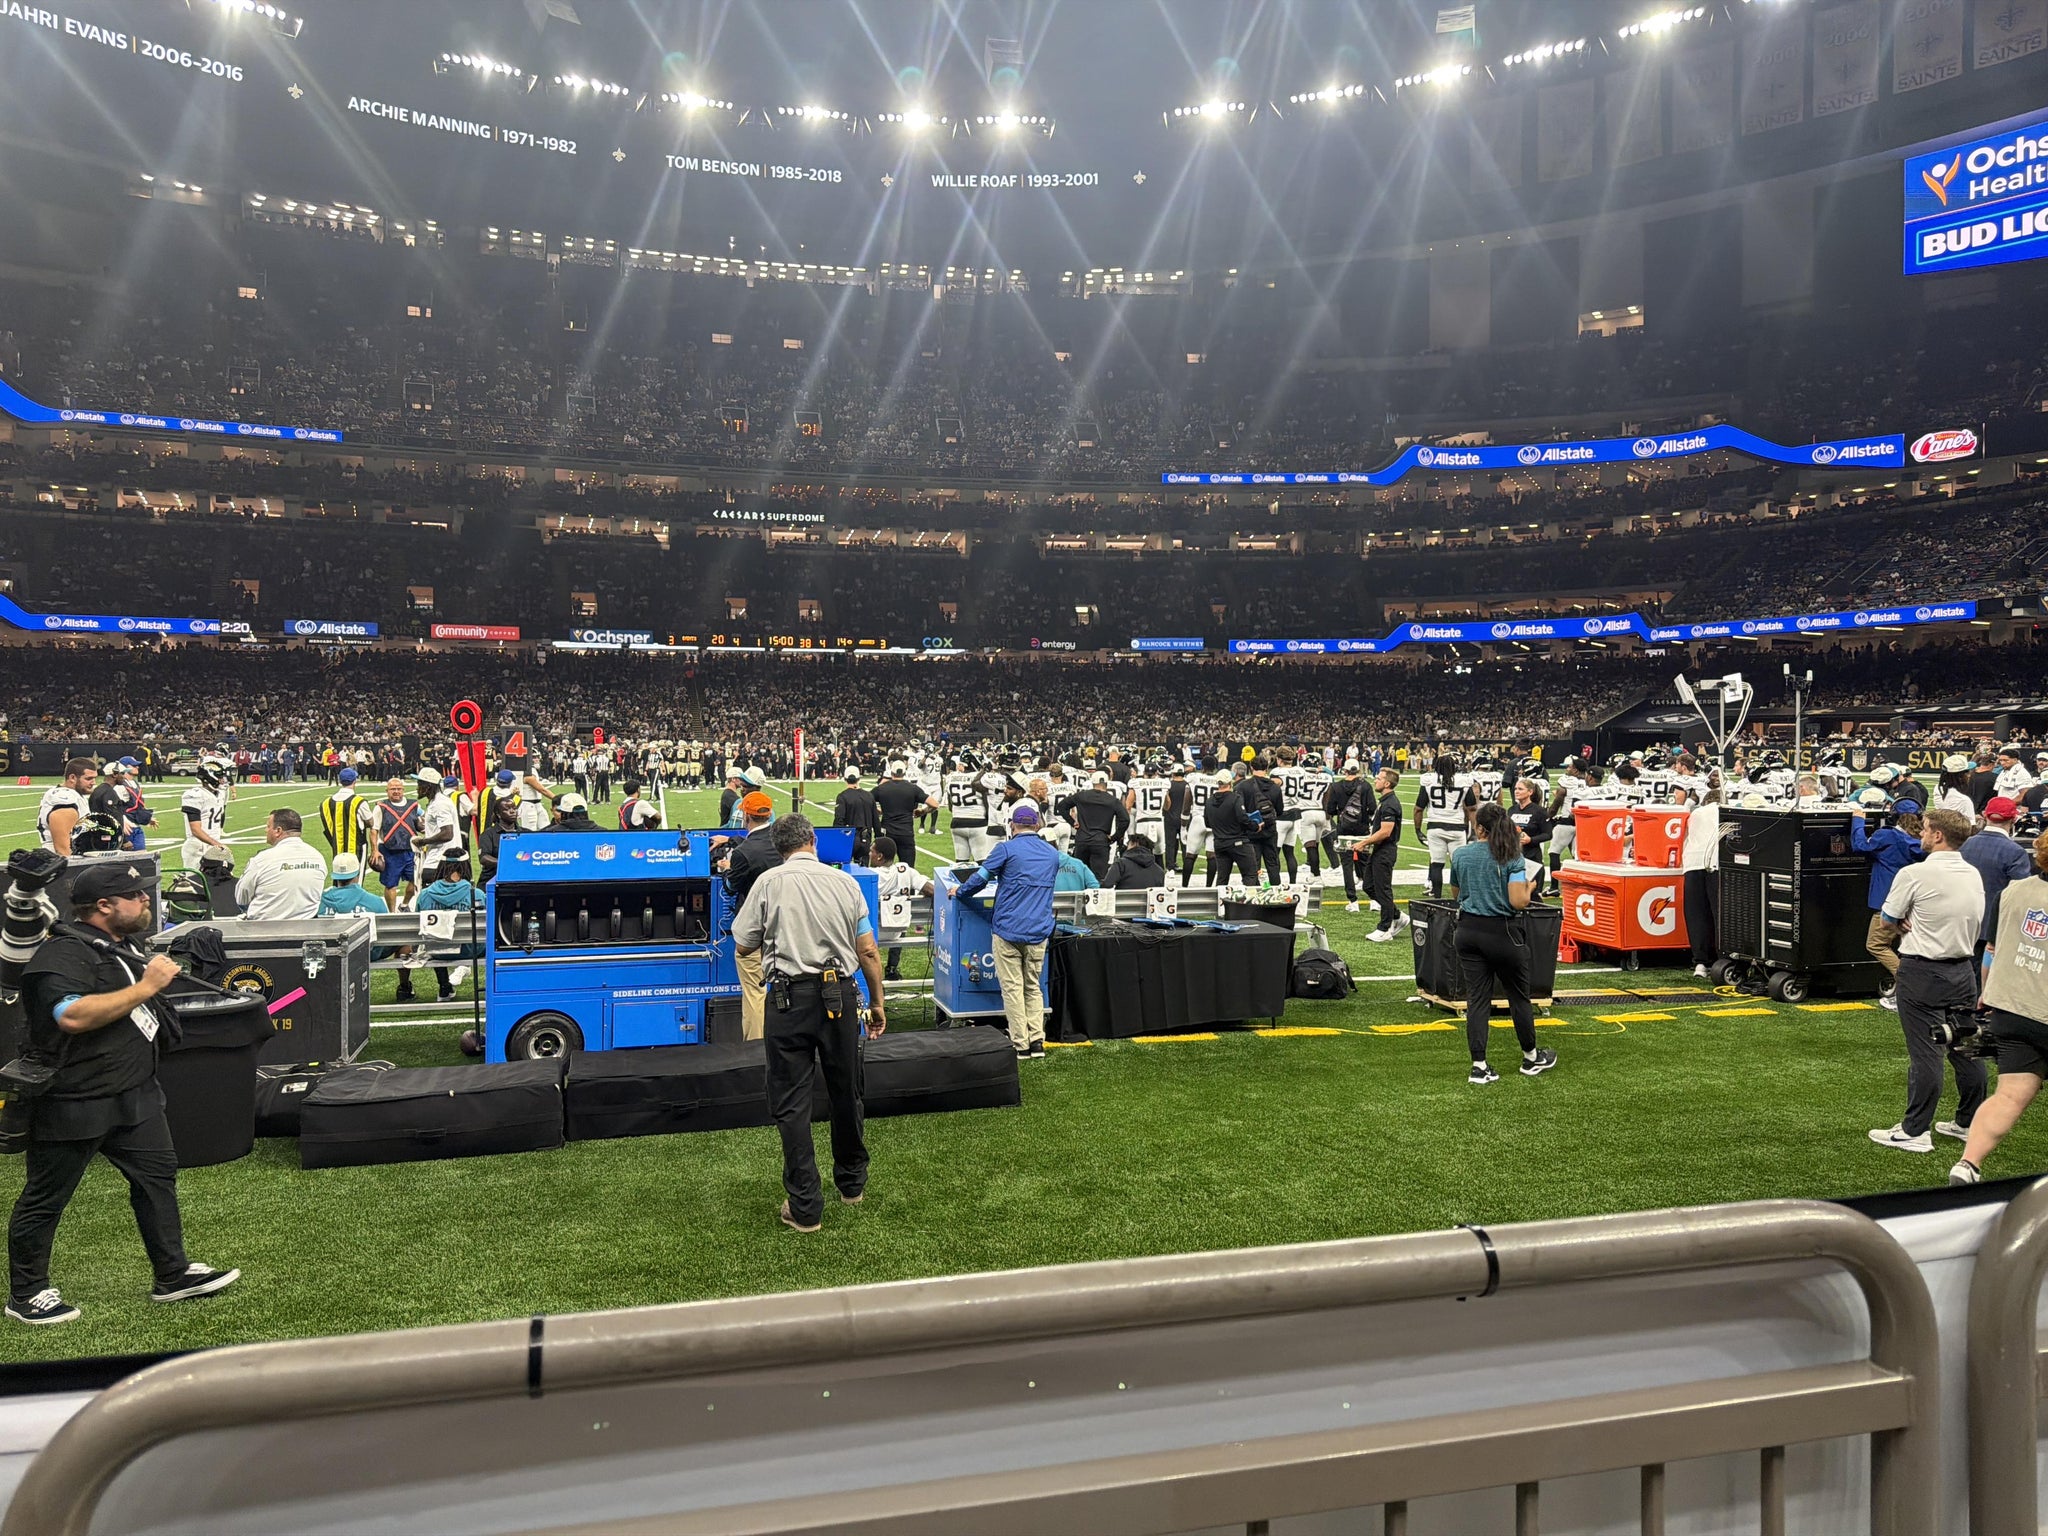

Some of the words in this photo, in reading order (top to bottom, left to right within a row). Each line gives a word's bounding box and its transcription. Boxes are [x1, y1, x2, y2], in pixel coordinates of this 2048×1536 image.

[0, 2, 58, 30] JAHRI
[65, 17, 128, 50] EVANS
[141, 39, 244, 82] 2006-2016
[1978, 34, 2042, 66] SAINTS
[1897, 63, 1957, 90] SAINTS
[347, 95, 409, 123] ARCHIE
[411, 112, 491, 141] MANNING
[502, 128, 578, 156] 1971-1982
[665, 155, 699, 170] TOM
[702, 158, 760, 176] BENSON
[770, 164, 842, 184] 1985-2018
[931, 174, 977, 187] WILLIE
[980, 174, 1017, 187] ROAF
[1027, 172, 1099, 187] 1993-2001
[1969, 163, 2048, 201] Healt
[1923, 221, 1998, 259] BUD
[74, 411, 105, 423] Allstate
[135, 416, 166, 427] Allstate
[194, 421, 225, 432] Allstate
[252, 426, 281, 436] Allstate
[308, 431, 337, 441] Allstate
[1658, 435, 1709, 454] Allstate
[1838, 442, 1898, 460] Allstate
[1914, 430, 1972, 460] Cane's
[1433, 450, 1482, 466] Allstate
[1541, 446, 1597, 462] Allstate
[712, 510, 766, 520] CAESARS
[767, 512, 825, 523] SUPERDOME
[1868, 612, 1901, 624] Allstate
[1931, 607, 1967, 618] Allstate
[62, 618, 101, 629] Allstate
[135, 620, 173, 631] Allstate
[222, 622, 249, 633] 2:20
[1755, 620, 1785, 632] Allstate
[1810, 616, 1841, 628] Allstate
[317, 623, 369, 636] Allstate
[436, 624, 488, 639] Community
[1423, 627, 1464, 639] Allstate
[1510, 623, 1556, 637] Allstate
[1703, 624, 1731, 636] Allstate
[583, 630, 650, 644] Ochsner
[668, 635, 675, 646] 3
[711, 634, 725, 645] 20
[733, 637, 740, 646] 4
[769, 635, 794, 646] 15:00
[800, 638, 812, 648] 38
[922, 637, 953, 648] COX
[1041, 639, 1076, 650] entergy
[1248, 642, 1274, 651] Allstate
[1299, 642, 1325, 651] Allstate
[1350, 641, 1376, 651] Allstate
[505, 731, 528, 757] 4
[949, 784, 978, 807] 62
[1301, 781, 1328, 800] 57
[1479, 781, 1501, 802] 32
[1141, 788, 1162, 811] 15
[1430, 786, 1465, 810] 97
[208, 806, 223, 830] 14
[1606, 818, 1623, 840] G
[1664, 818, 1682, 840] G
[532, 851, 580, 861] Copilot
[1793, 840, 1802, 869] VISITOR
[280, 862, 320, 871] Acadian
[1156, 893, 1165, 903] G
[1167, 905, 1175, 914] G
[1575, 893, 1596, 927] G
[1637, 885, 1676, 936] G
[1793, 900, 1801, 944] TECHNOLOGY
[2025, 920, 2046, 938] NFL
[2017, 942, 2046, 961] MEDIA
[222, 964, 254, 990] JACKSONVILLE
[983, 971, 994, 980] by
[613, 988, 653, 998] SIDELINE
[653, 985, 730, 997] COMMUNICATIONS
[282, 1018, 292, 1031] 19
